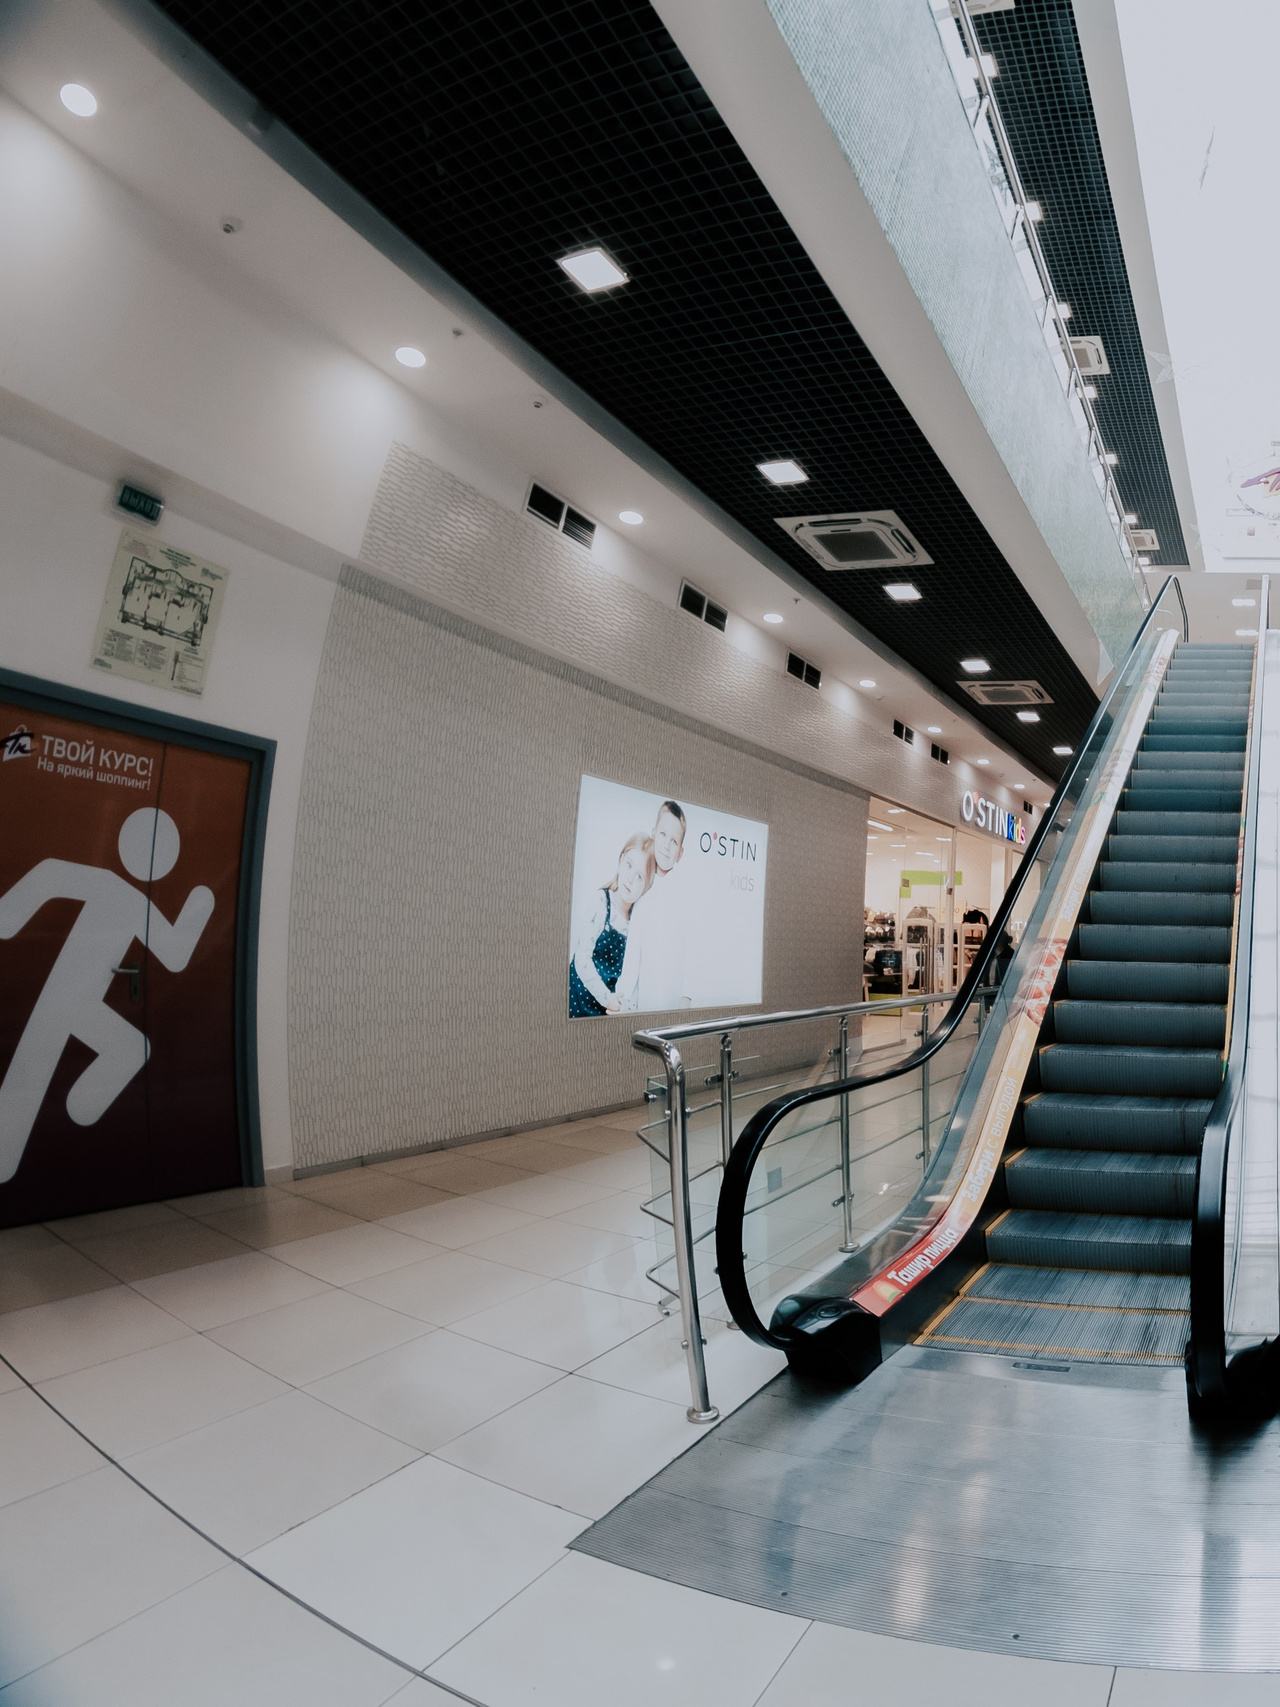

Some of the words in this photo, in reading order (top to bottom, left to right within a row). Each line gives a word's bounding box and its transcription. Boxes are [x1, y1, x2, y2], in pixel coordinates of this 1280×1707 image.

[122, 488, 160, 519] ВЫХОД
[42, 735, 95, 765] ТВОЙ
[99, 748, 154, 777] КУРС!
[37, 757, 54, 772] На
[56, 763, 94, 779] яркий
[96, 771, 151, 791] шоппинг!
[700, 832, 757, 862] O'STIN
[730, 870, 754, 892] kids
[962, 1151, 995, 1203] Забери
[887, 1253, 934, 1287] Ташир
[925, 1227, 959, 1260] пицца
